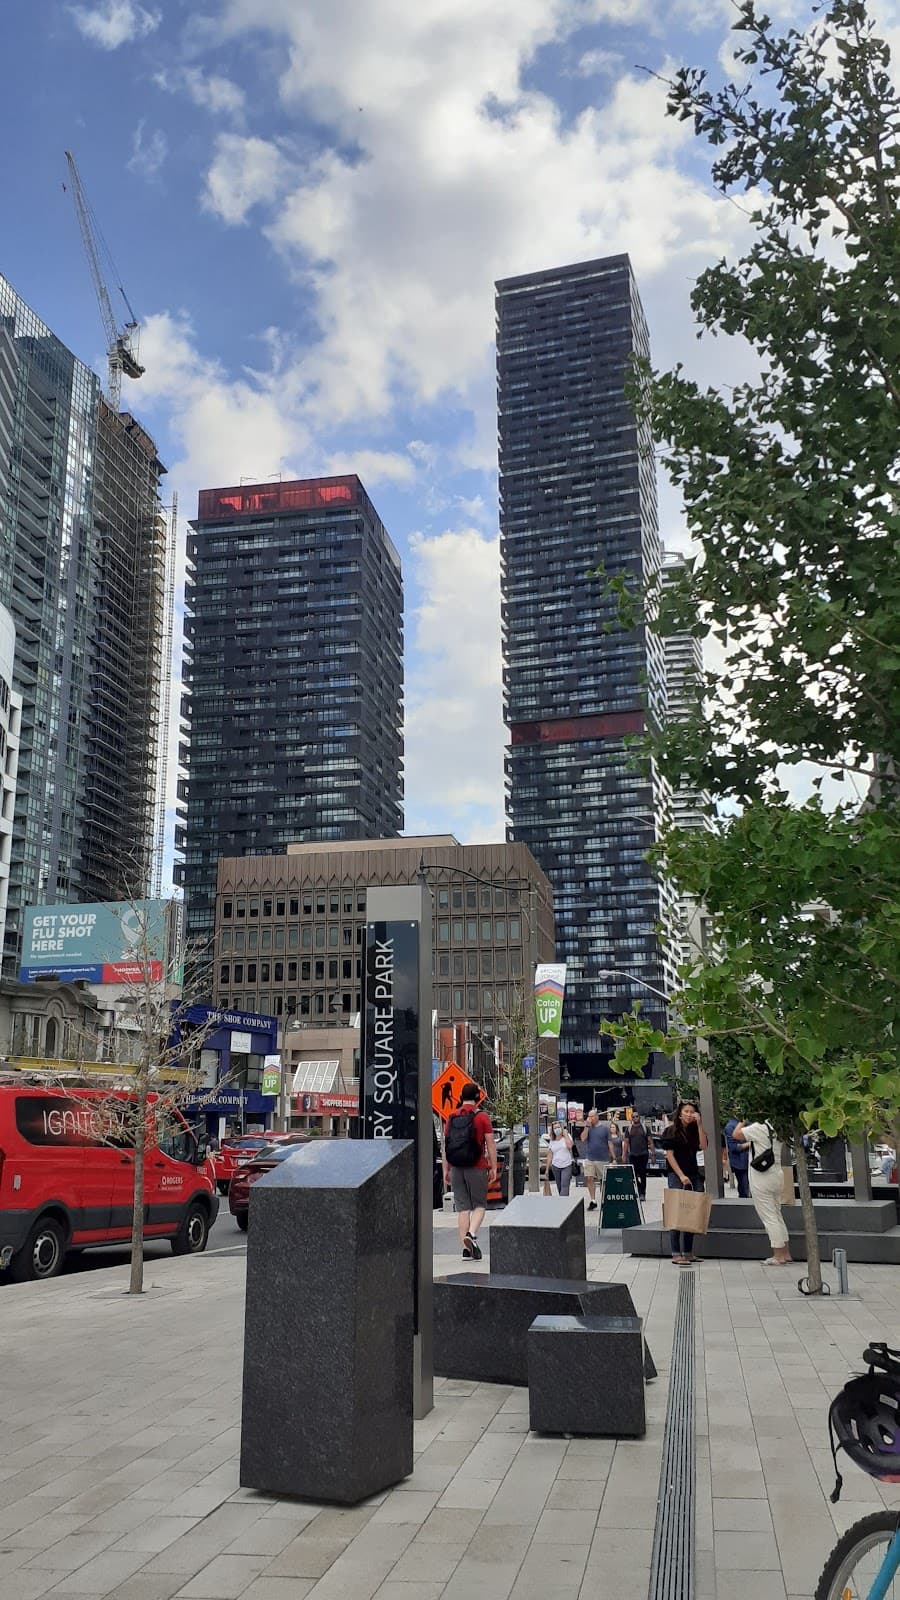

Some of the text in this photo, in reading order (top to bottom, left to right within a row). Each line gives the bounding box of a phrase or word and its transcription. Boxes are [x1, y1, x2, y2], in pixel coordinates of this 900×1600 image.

[33, 913, 96, 928] GET YOUR
[32, 925, 94, 940] FLU SHOT
[31, 939, 64, 952] HERE
[537, 999, 560, 1007] Catch
[207, 1011, 271, 1029] THE SHOE COMPANY
[539, 1008, 557, 1024] UP
[373, 938, 398, 1140] RY SQUARE PARK
[264, 1079, 277, 1088] UP
[218, 1095, 248, 1105] COMPANY
[166, 1176, 184, 1185] ROGERS
